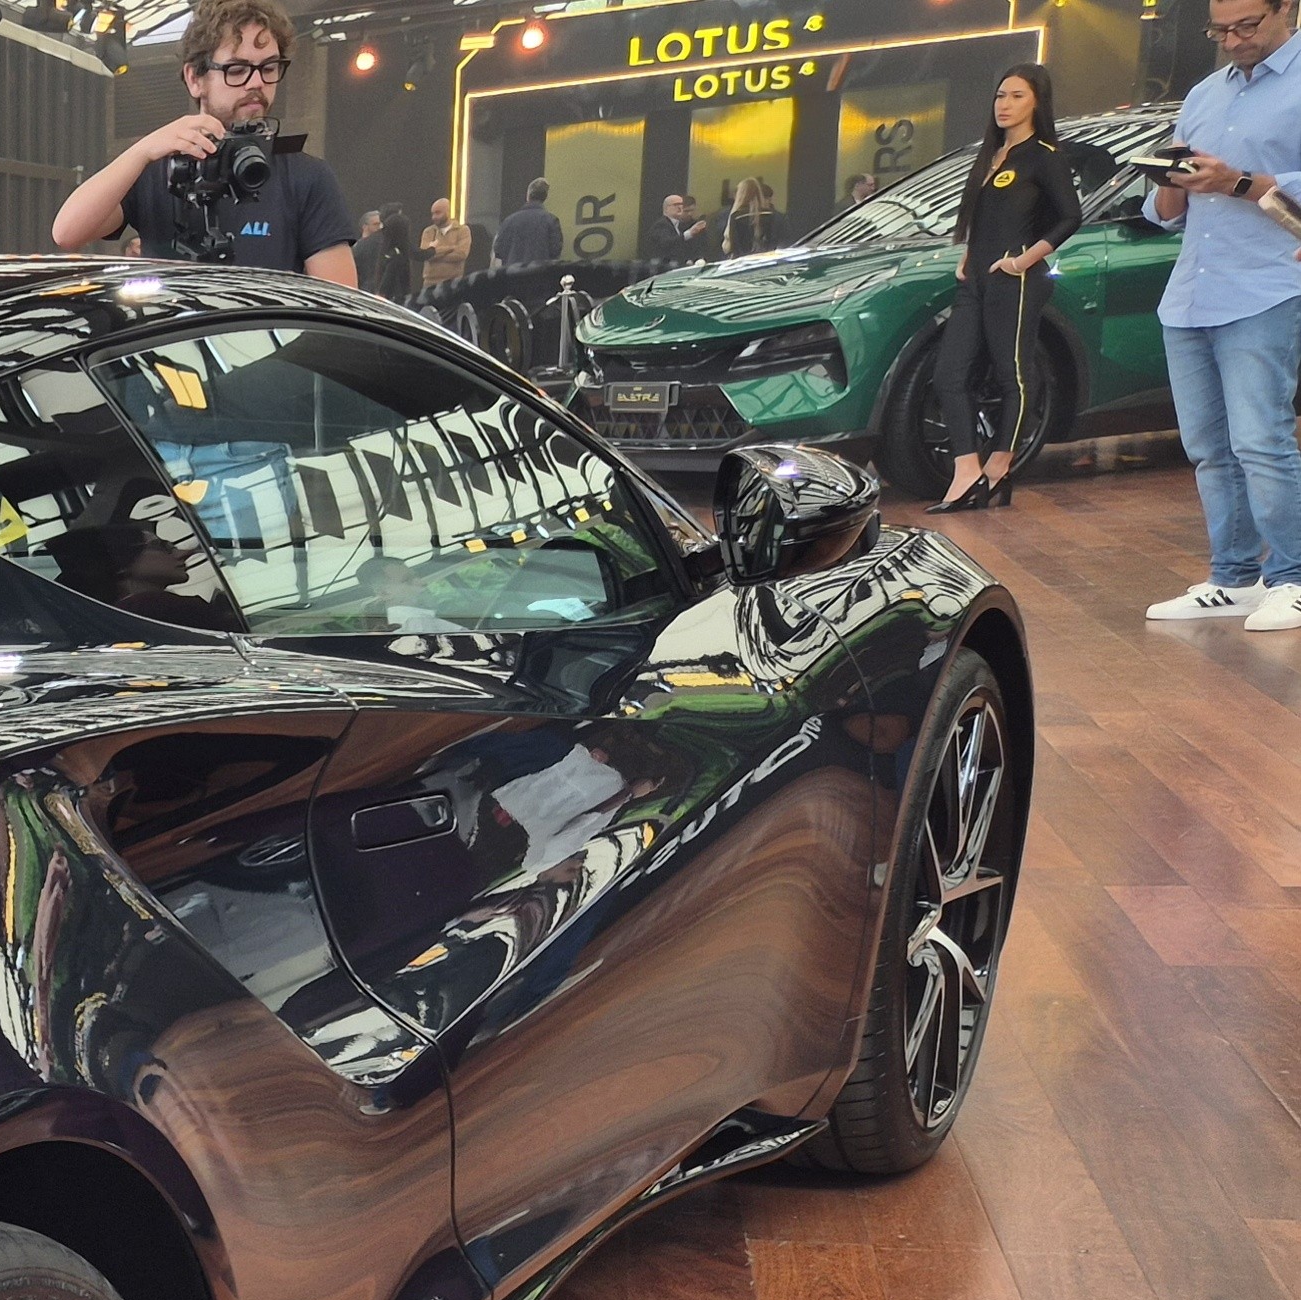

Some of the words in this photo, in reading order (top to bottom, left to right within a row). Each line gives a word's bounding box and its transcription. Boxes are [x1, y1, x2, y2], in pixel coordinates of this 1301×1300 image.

[628, 19, 791, 66] LOTUS
[673, 65, 791, 102] LOTUS
[873, 119, 914, 174] RS
[573, 192, 616, 260] OR
